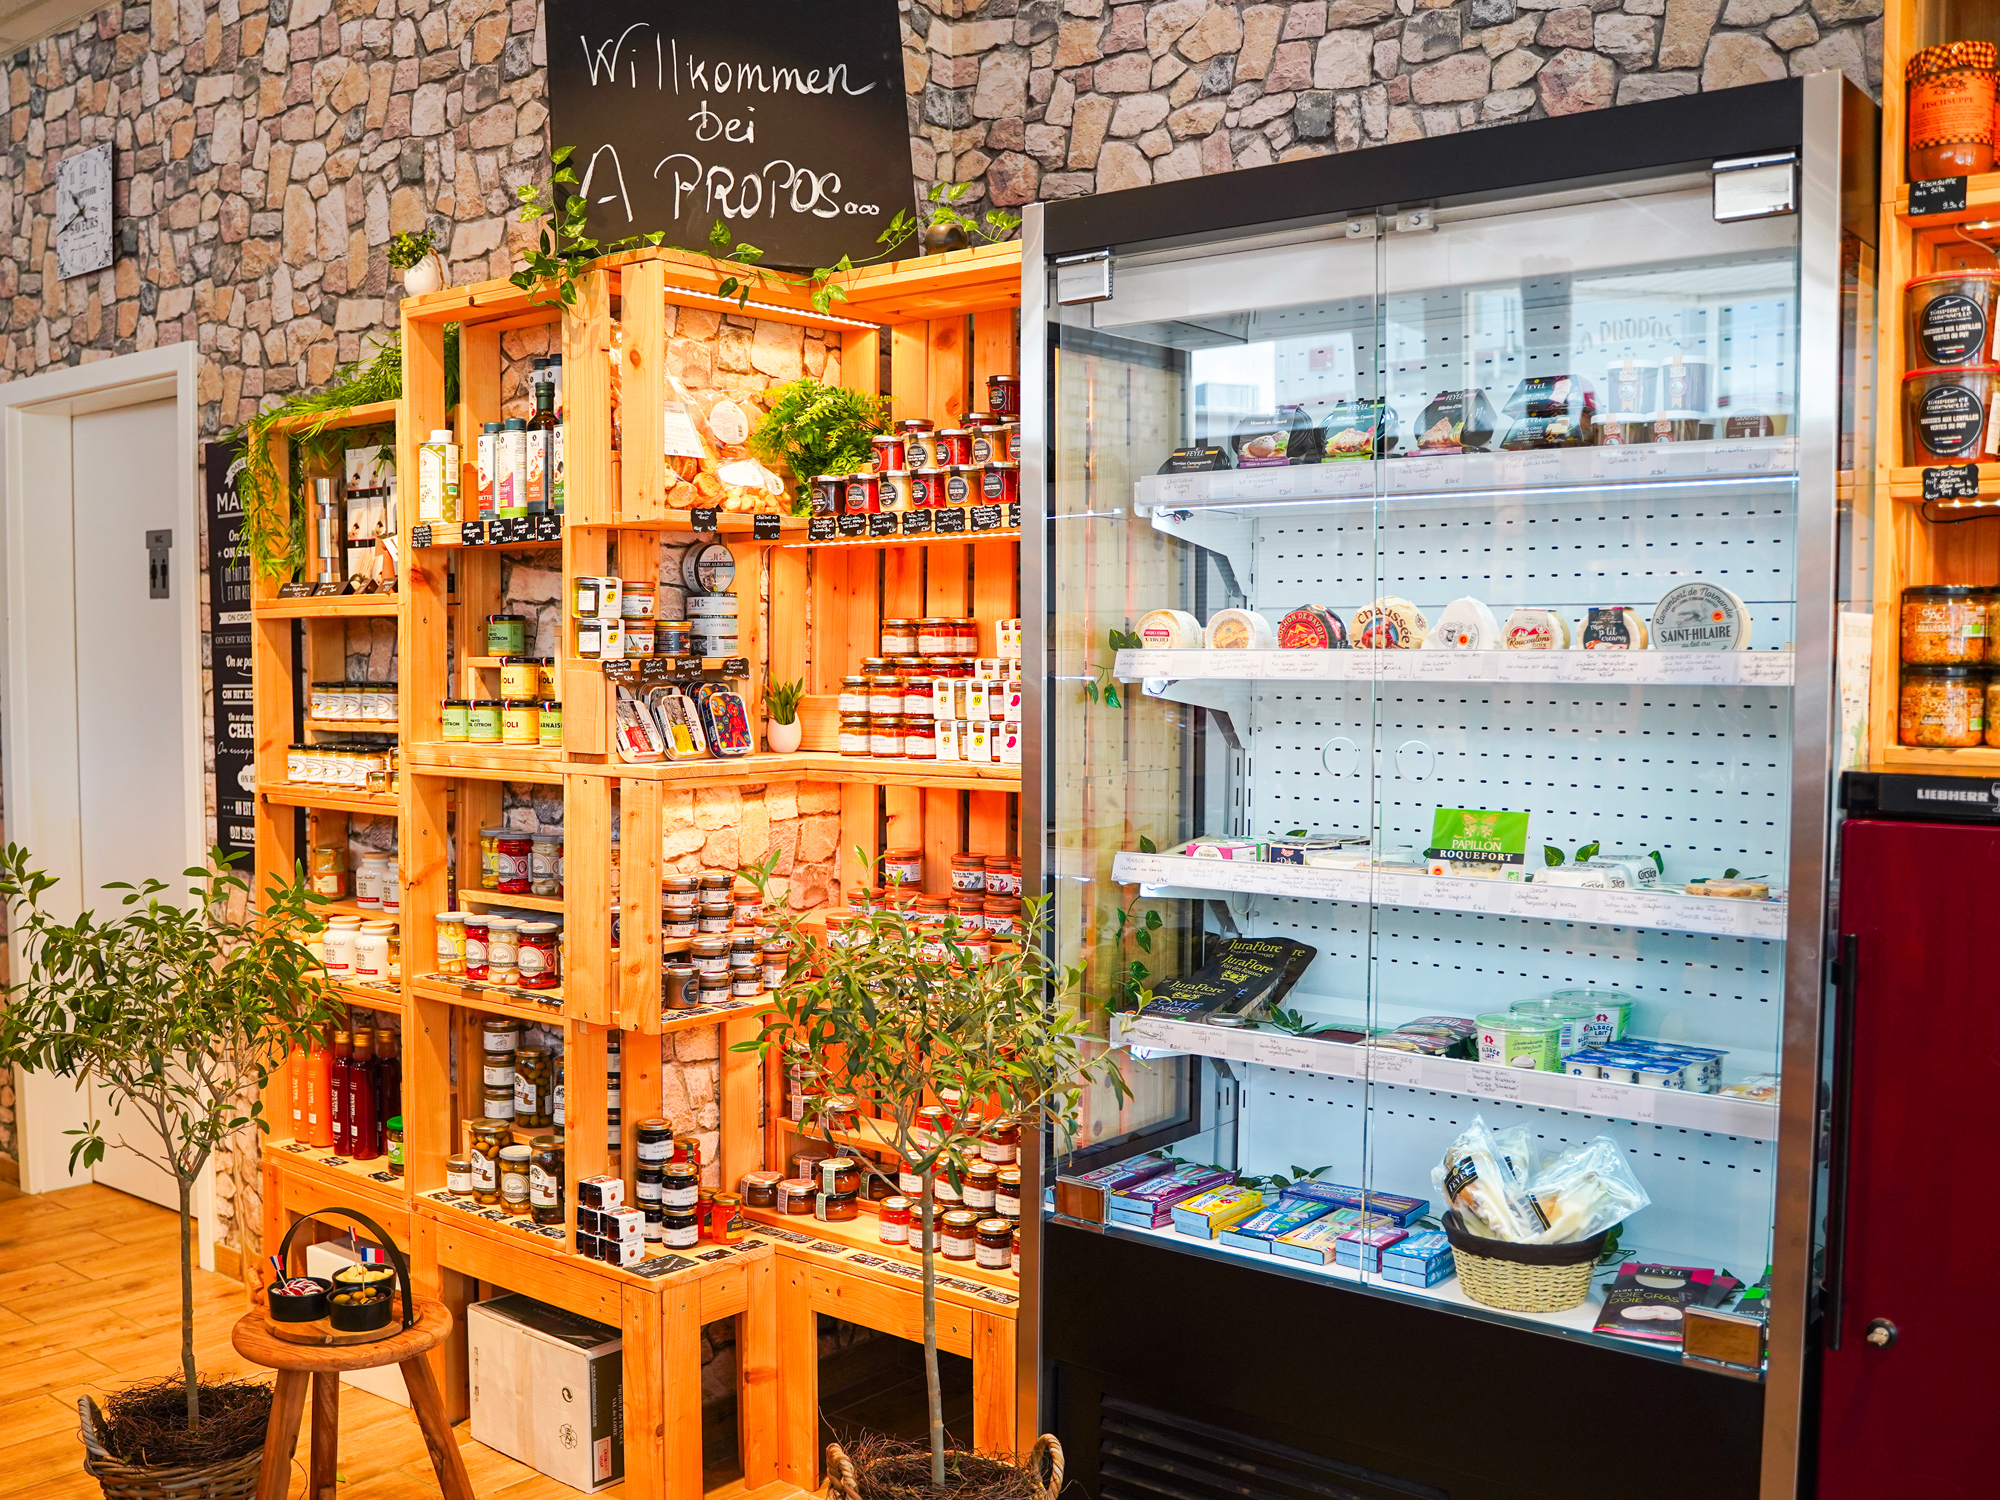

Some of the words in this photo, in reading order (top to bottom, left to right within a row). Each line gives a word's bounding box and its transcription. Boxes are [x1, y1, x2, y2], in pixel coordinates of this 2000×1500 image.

[580, 22, 877, 95] Willkommen
[1922, 96, 1975, 110] FISCHSUPPE
[688, 100, 755, 144] bei
[579, 144, 633, 223] A
[1186, 448, 1205, 457] FEYEL
[1655, 590, 1688, 625] Camembert
[1685, 588, 1698, 596] de
[1699, 586, 1733, 619] Normandie
[1308, 614, 1326, 641] SAVOIE
[1661, 625, 1732, 643] SAINT-HILAIRE
[225, 636, 235, 644] EST
[1508, 634, 1550, 647] Roucoulons
[226, 655, 235, 667] On
[222, 690, 232, 699] ON
[233, 690, 244, 699] RIT
[1916, 789, 1989, 802] LIEBHERR
[1452, 839, 1502, 851] PAPILLON
[1440, 850, 1513, 862] ROQUEFORT
[1229, 939, 1283, 953] JuraFlore
[1223, 954, 1274, 974] JuraFlore
[1241, 967, 1264, 978] Rousses
[1169, 980, 1226, 994] JuraFlore
[1160, 1005, 1192, 1014] MOIS
[1644, 1267, 1684, 1277] FEYEL
[1643, 1292, 1680, 1303] GRAS
